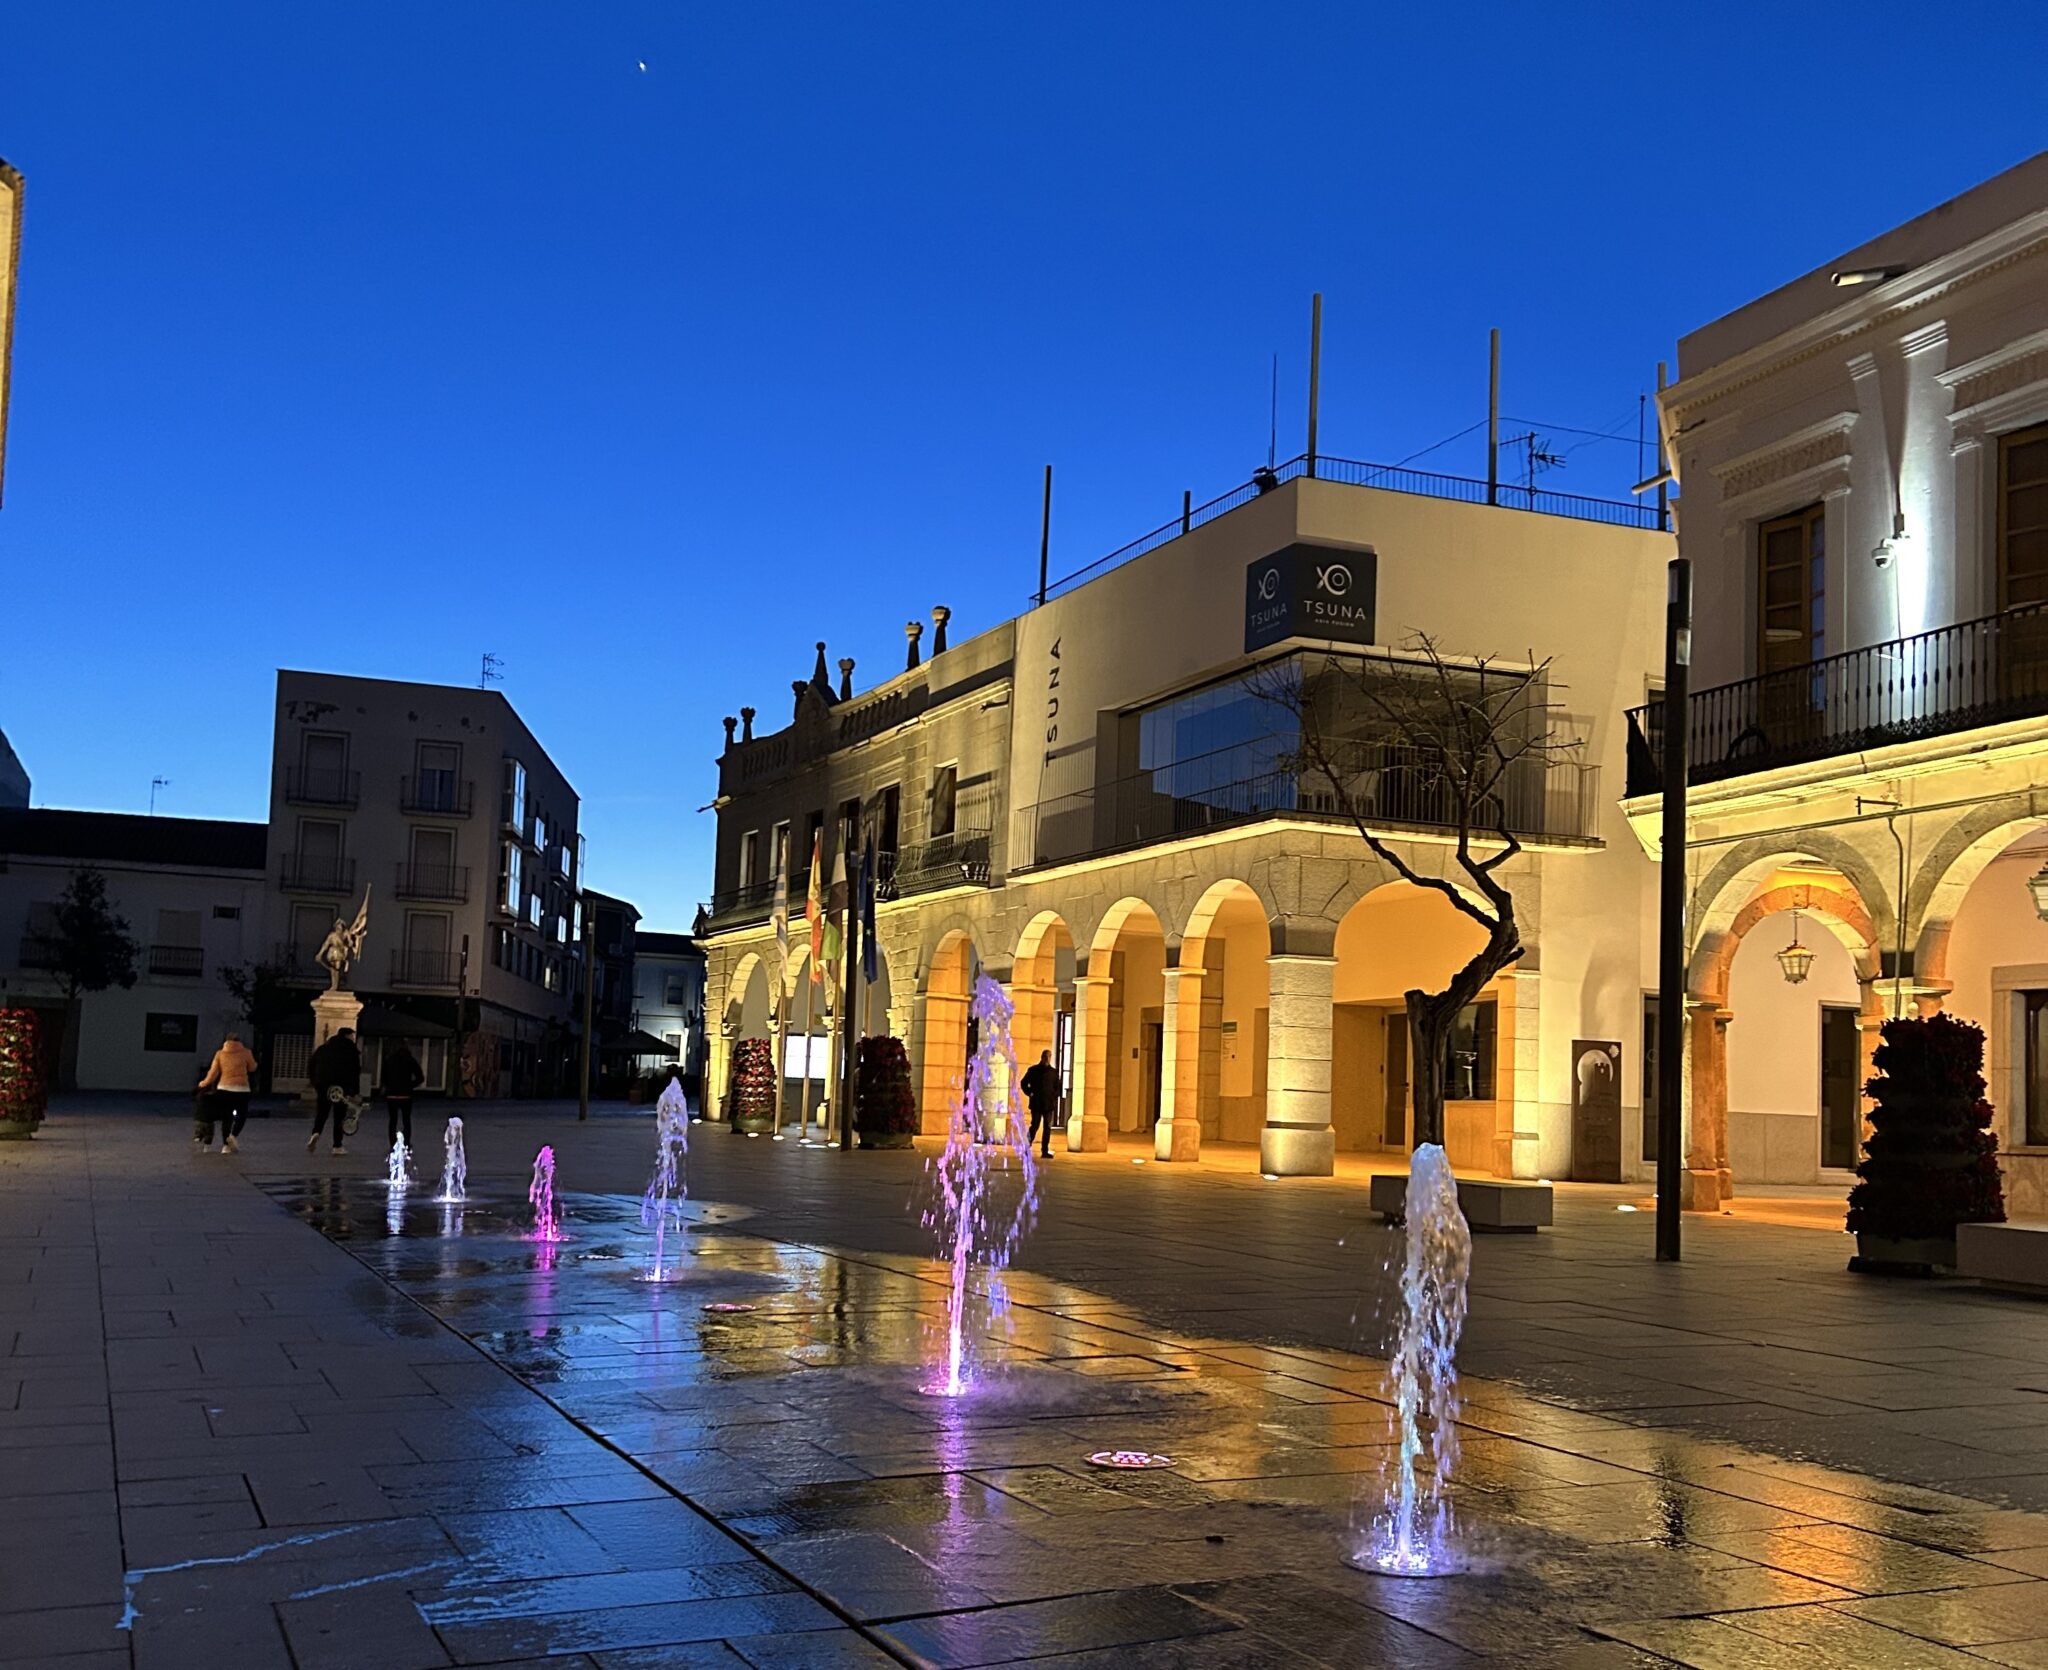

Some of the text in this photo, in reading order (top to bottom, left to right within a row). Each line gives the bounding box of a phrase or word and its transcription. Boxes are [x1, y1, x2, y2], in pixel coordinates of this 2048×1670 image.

[1251, 602, 1287, 627] TSUNA
[1304, 600, 1366, 620] TSUNA
[1046, 636, 1062, 768] TSUNA
